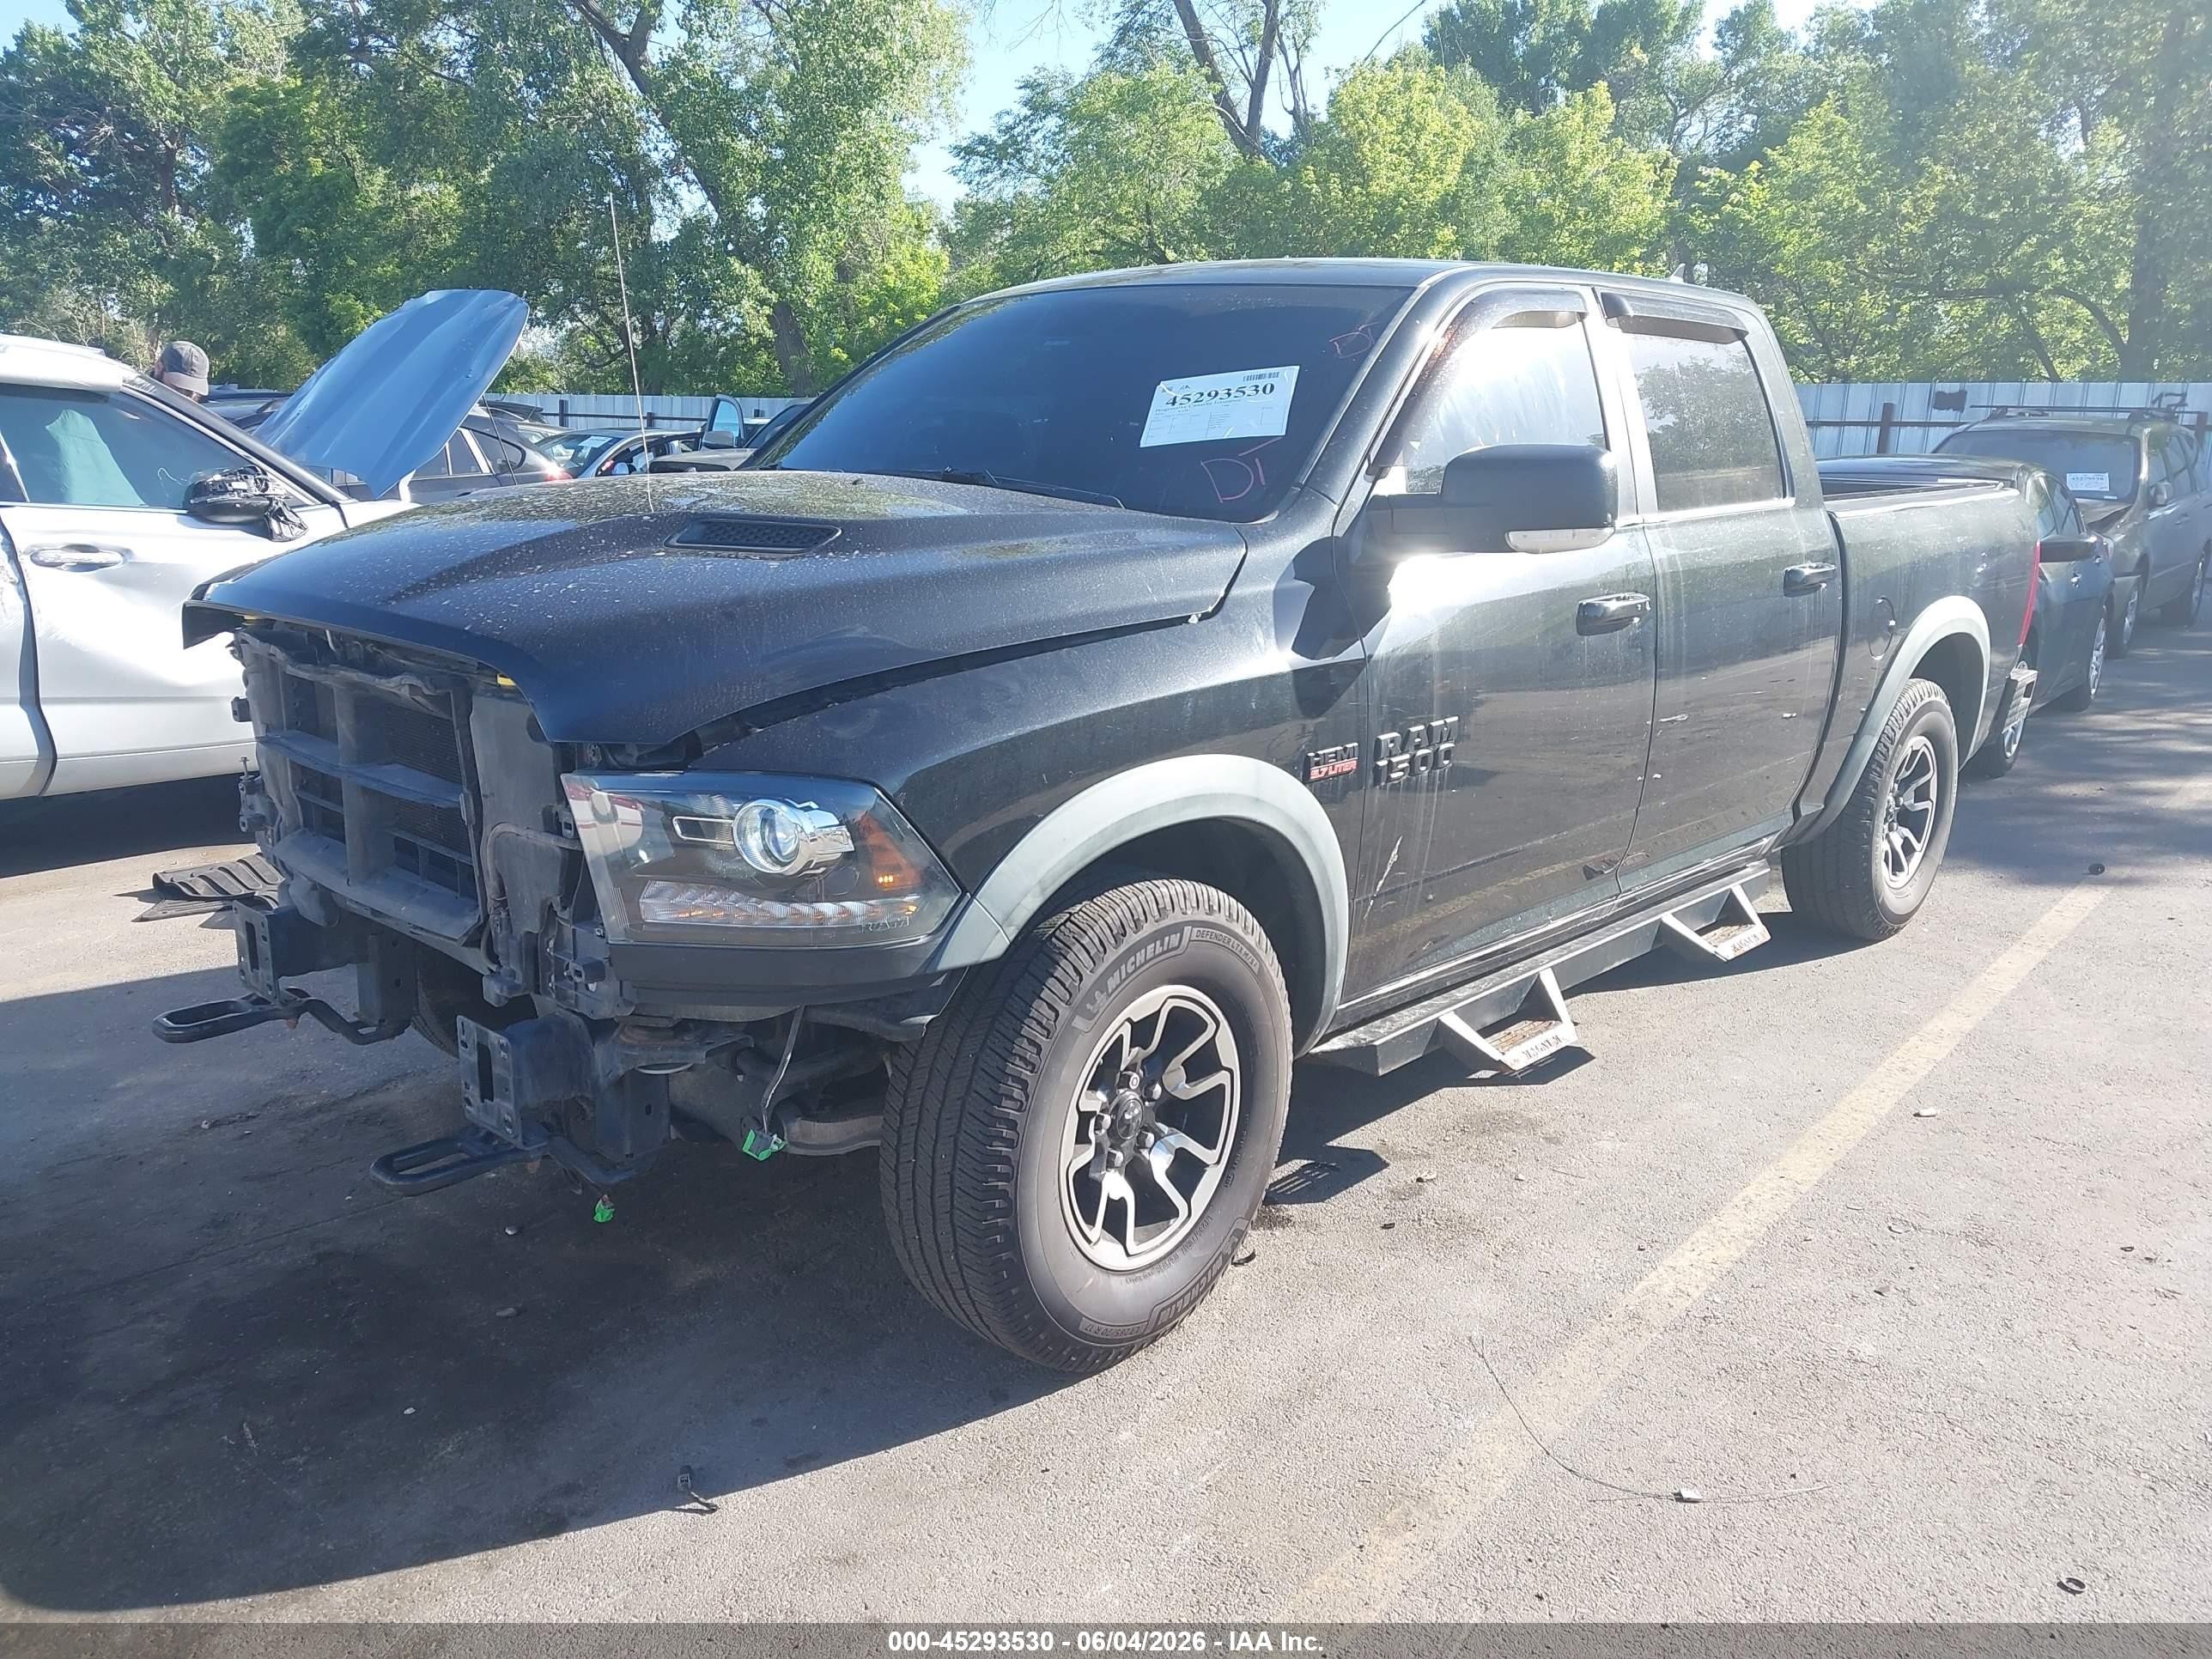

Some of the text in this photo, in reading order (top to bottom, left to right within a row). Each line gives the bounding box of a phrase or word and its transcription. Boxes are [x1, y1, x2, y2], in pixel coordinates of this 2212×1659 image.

[1165, 383, 1275, 406] 45293530
[1374, 715, 1459, 759] RAM
[1304, 742, 1359, 767] HEMI
[1374, 743, 1455, 787] 1500
[1328, 760, 1358, 775] LITER
[861, 915, 910, 933] RAM
[1195, 929, 1231, 944] DEFENDER
[1231, 939, 1245, 954] LTX
[1107, 932, 1181, 994] MICHELIN
[1158, 1250, 1224, 1327] MICHELIN
